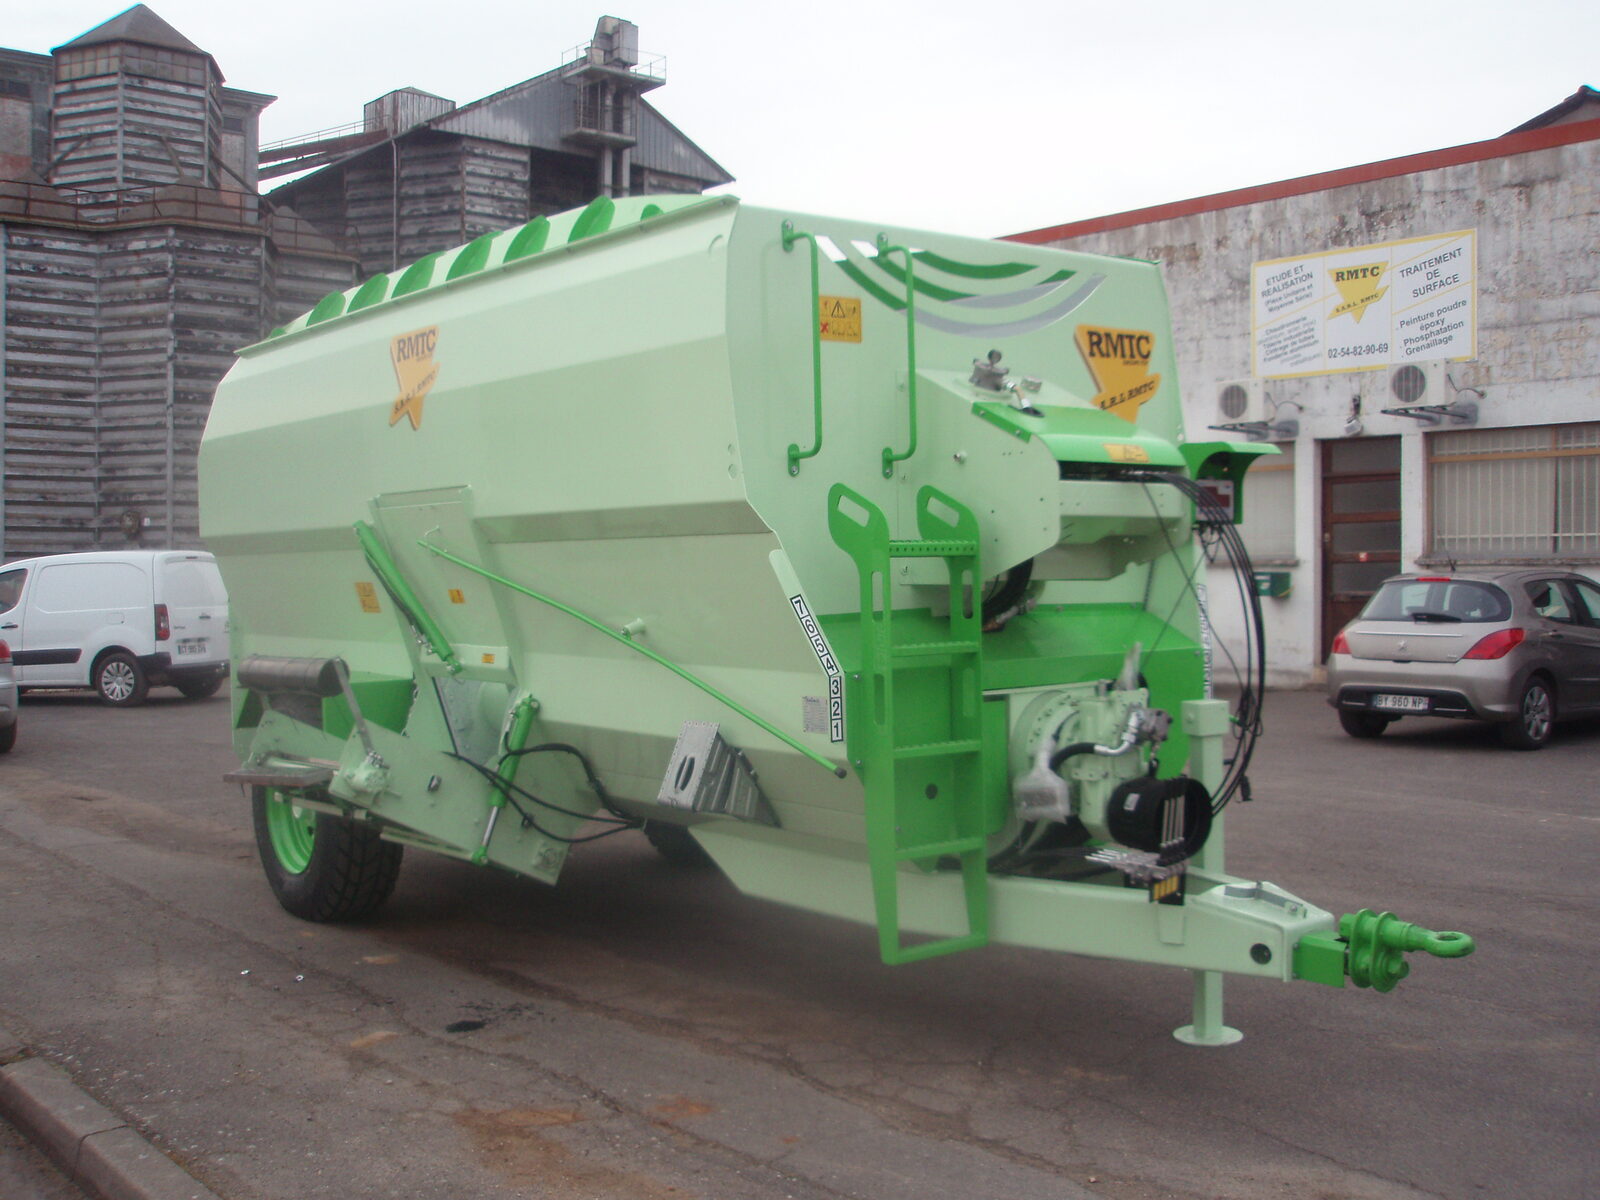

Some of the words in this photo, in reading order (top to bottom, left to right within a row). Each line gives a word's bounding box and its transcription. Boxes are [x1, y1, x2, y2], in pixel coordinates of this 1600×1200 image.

[1400, 247, 1463, 278] TRAITEMENT
[1265, 269, 1292, 286] ETUDE
[1293, 264, 1305, 275] ET
[1335, 266, 1380, 282] RMTC
[1426, 268, 1441, 281] DE
[1261, 271, 1313, 298] REALISATION
[1412, 273, 1460, 298] SURFACE
[1360, 292, 1380, 304] RMTC
[1400, 311, 1435, 329] Peinture
[1436, 300, 1467, 317] poudre
[1403, 320, 1465, 347] Phosphatation
[397, 328, 437, 363] RMTC
[1088, 330, 1152, 360] RMTC
[1405, 334, 1454, 356] Grenaillage
[794, 599, 804, 615] 7
[804, 618, 816, 634] 6
[814, 637, 825, 653] 5
[825, 657, 835, 672] 4
[831, 679, 840, 695] 3
[832, 701, 840, 717] 2
[833, 723, 840, 738] 1
